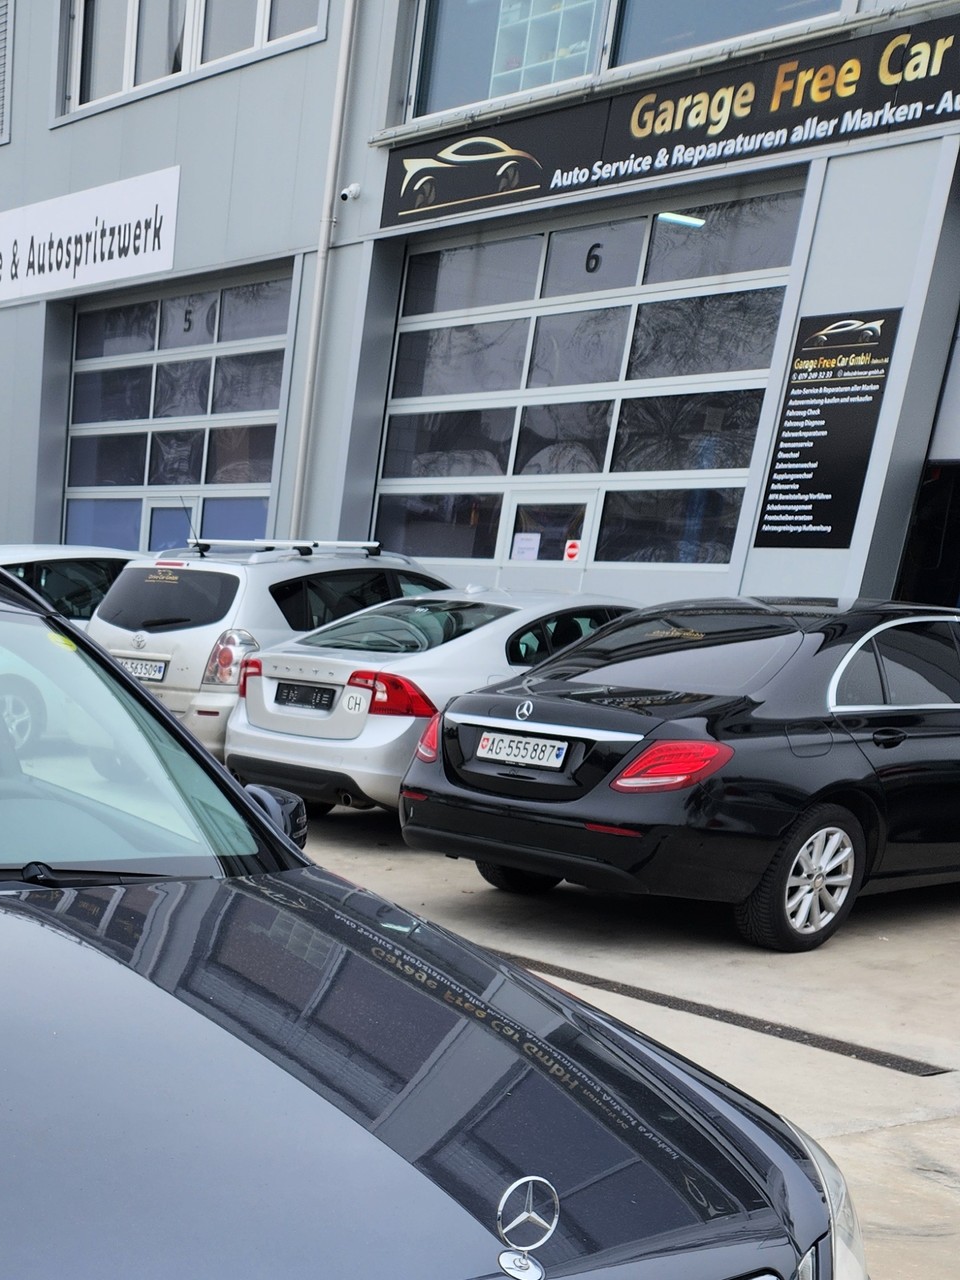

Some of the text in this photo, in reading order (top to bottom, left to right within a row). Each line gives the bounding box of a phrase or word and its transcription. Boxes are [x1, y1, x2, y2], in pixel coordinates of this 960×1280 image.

[630, 32, 956, 138] Garage Free Car
[549, 167, 589, 191] Auto
[589, 153, 653, 182] Service
[653, 149, 670, 168] &
[670, 128, 787, 168] Reparaturen
[789, 116, 840, 144] aller
[839, 102, 923, 135] Marken
[10, 239, 21, 281] &
[26, 203, 164, 280] Autospritzwerk
[585, 243, 603, 273] 6
[183, 309, 193, 333] 5
[794, 357, 818, 371] Garage
[818, 356, 836, 368] Free
[837, 354, 848, 366] Car
[849, 352, 872, 366] GmbH
[347, 695, 362, 712] CH
